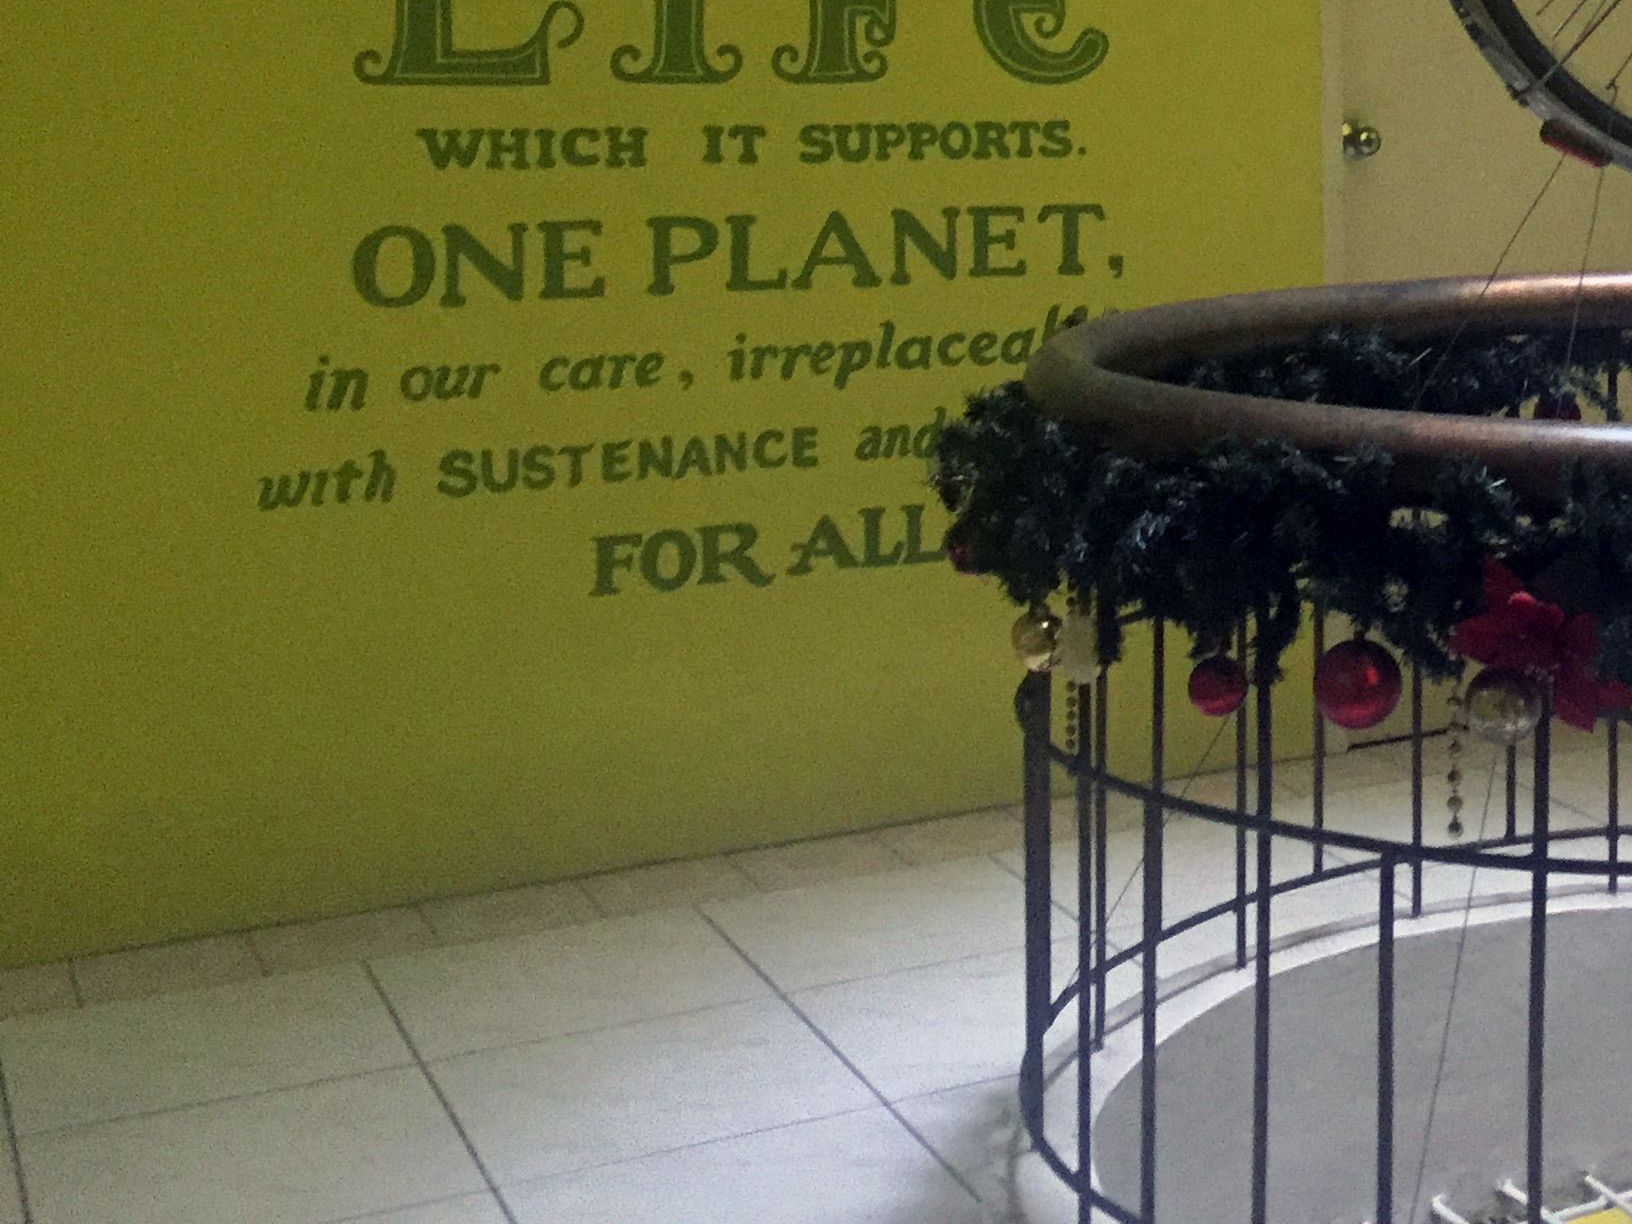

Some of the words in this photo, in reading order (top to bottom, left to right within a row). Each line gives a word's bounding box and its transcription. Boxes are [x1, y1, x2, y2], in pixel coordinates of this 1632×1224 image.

[416, 127, 648, 169] WHICH
[702, 125, 766, 164] IT
[800, 119, 1087, 164] SUPPORTS.
[351, 219, 606, 309] ONE
[646, 203, 1125, 296] PLANET,
[304, 355, 368, 412] in
[401, 358, 500, 401] our
[726, 302, 1089, 390] irreplacea
[258, 450, 396, 511] with
[436, 426, 818, 497] SUSTENANCE
[855, 406, 947, 461] and
[589, 522, 776, 597] FOR
[787, 504, 950, 576] ALL
